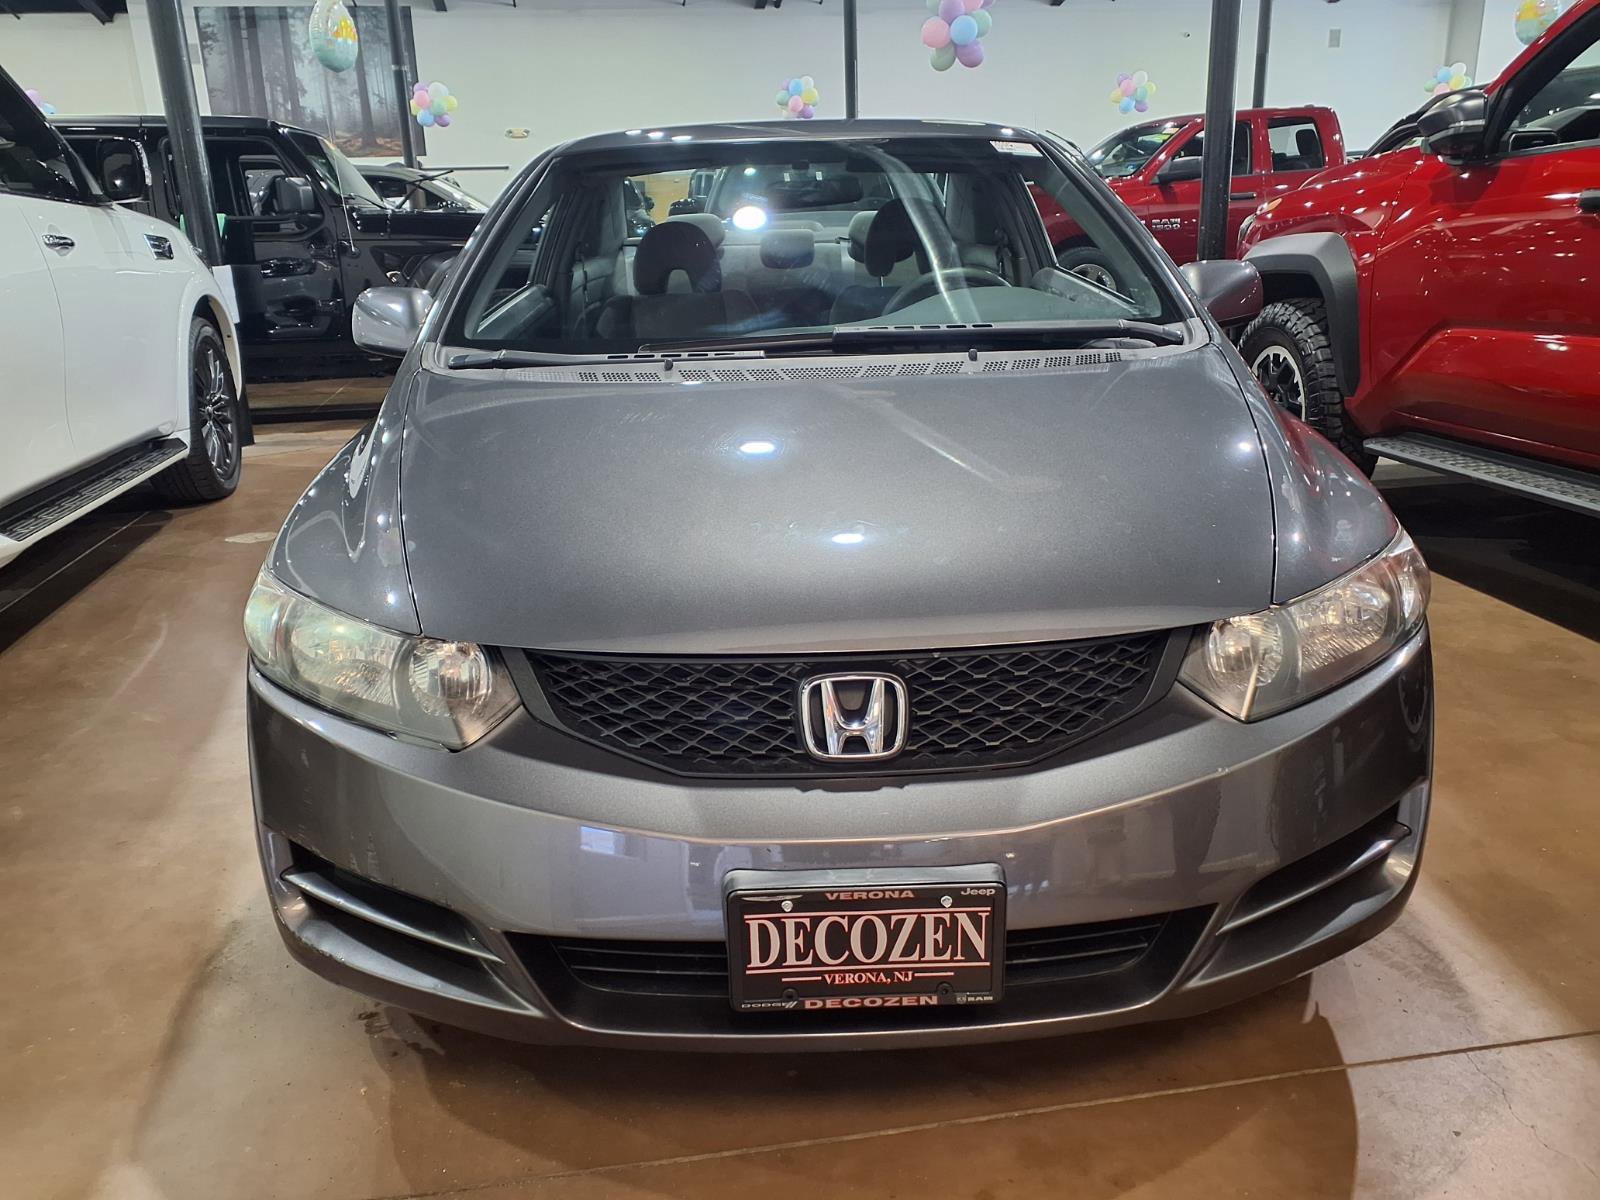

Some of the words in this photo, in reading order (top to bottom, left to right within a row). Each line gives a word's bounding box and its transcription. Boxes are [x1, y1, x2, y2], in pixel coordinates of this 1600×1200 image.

[825, 890, 915, 901] VERONA
[960, 887, 996, 897] Jeep
[744, 912, 990, 967] DECOZEN
[824, 972, 892, 985] VERONA,
[893, 971, 914, 983] NJ
[804, 996, 938, 1009] DECOZEN
[967, 995, 994, 1003] RAM
[741, 1001, 788, 1009] DODGE
